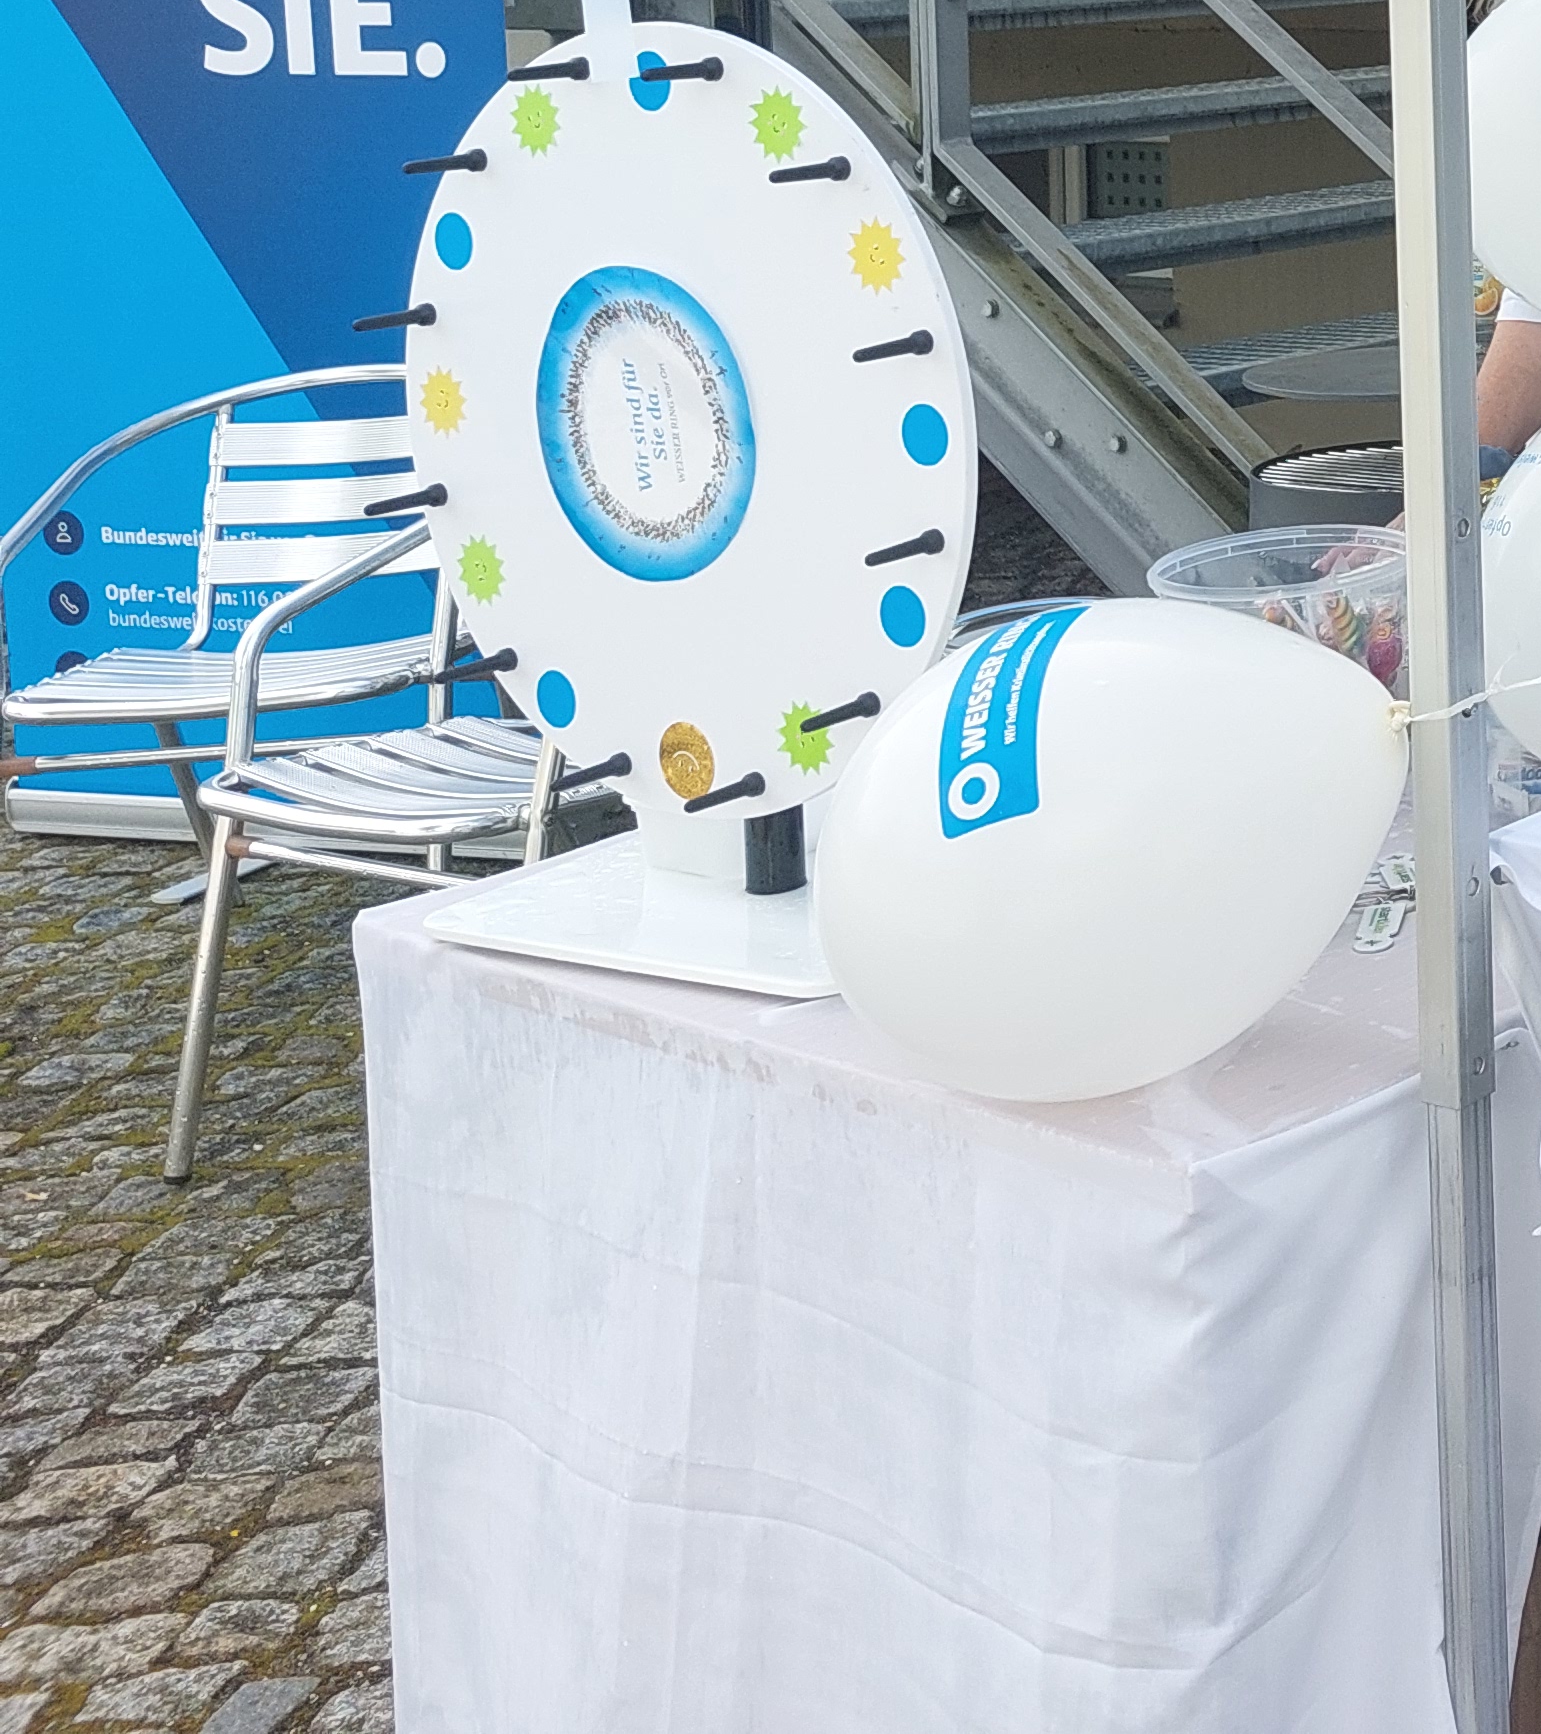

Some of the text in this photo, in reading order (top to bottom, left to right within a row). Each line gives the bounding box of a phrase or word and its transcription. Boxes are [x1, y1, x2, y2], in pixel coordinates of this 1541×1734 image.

[621, 358, 653, 492] Wir sind für
[645, 385, 668, 461] Sie da.
[671, 432, 686, 484] WEISSER
[101, 526, 202, 548] Bundeswei
[109, 609, 200, 631] bundeswei
[960, 652, 1008, 761] WEISSER
